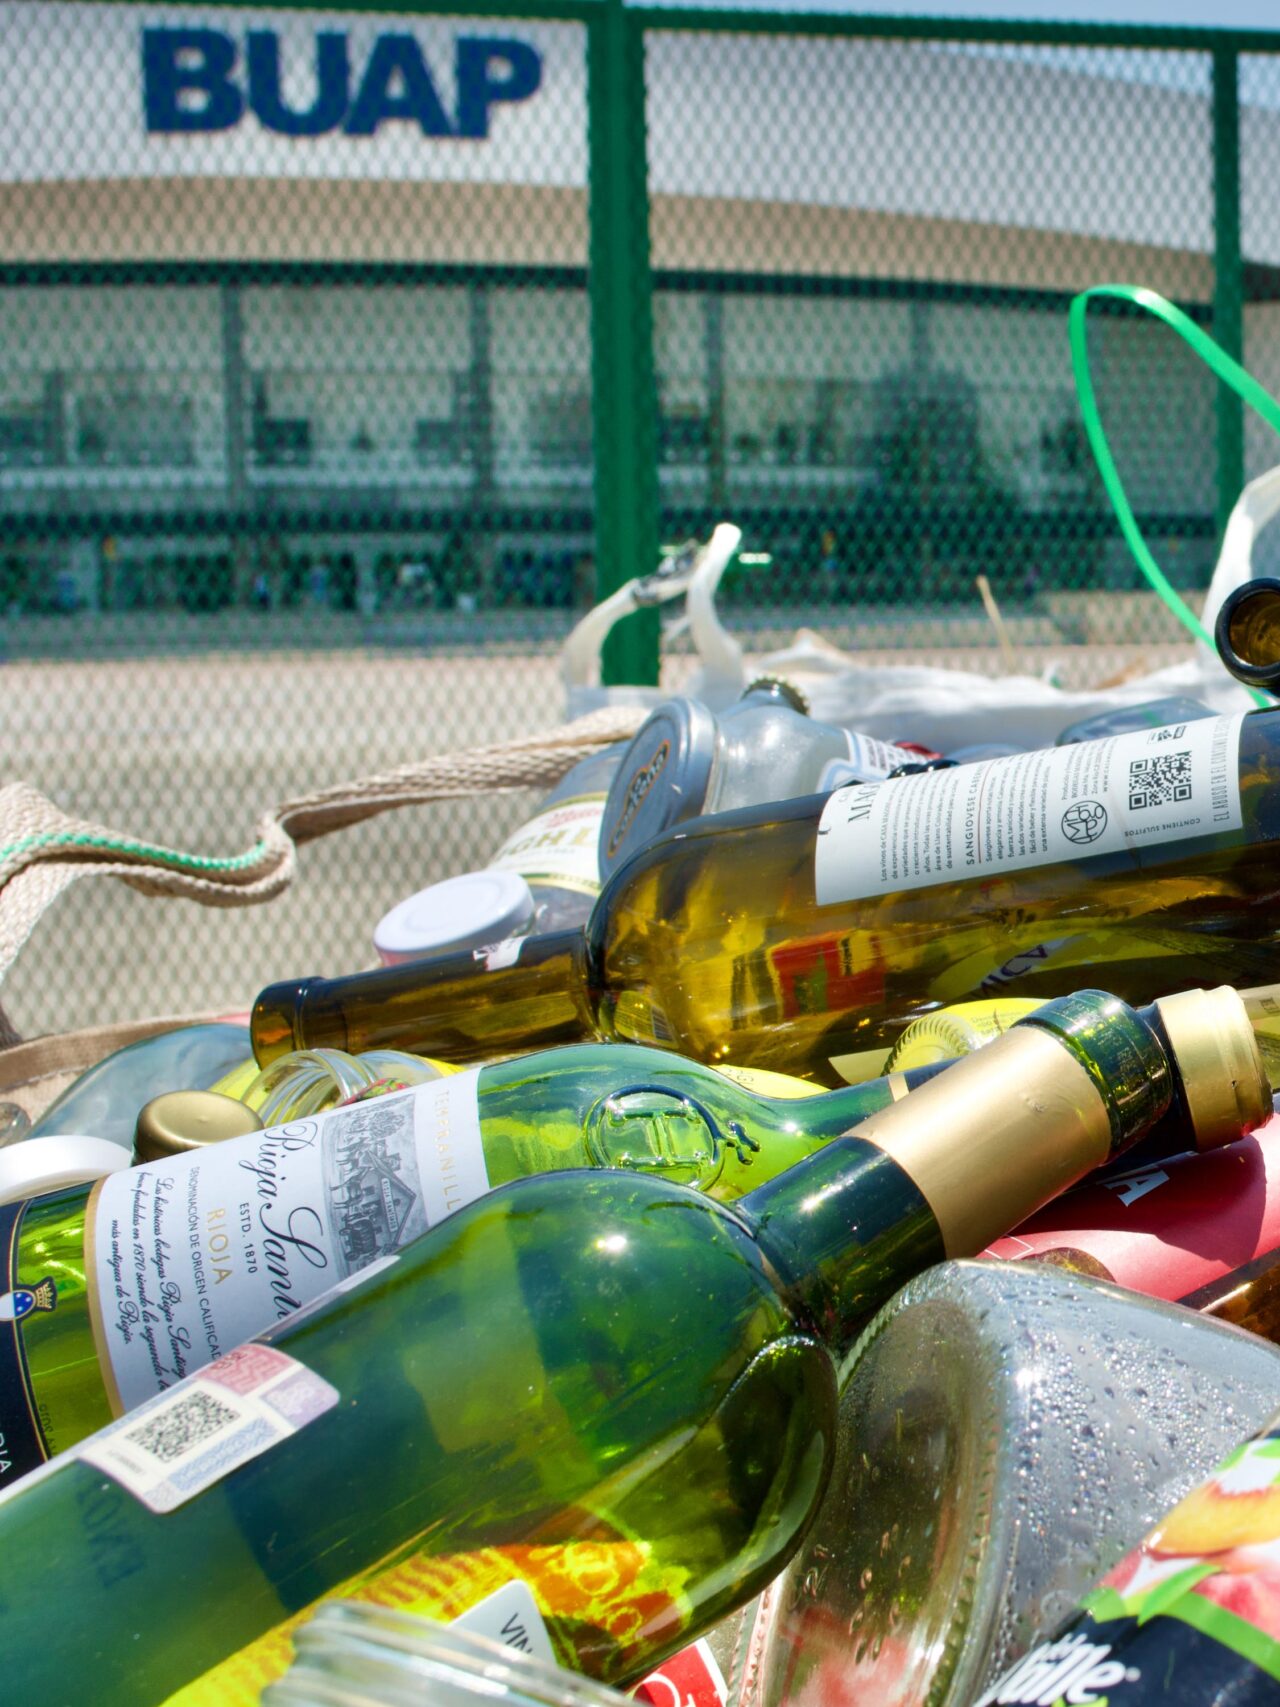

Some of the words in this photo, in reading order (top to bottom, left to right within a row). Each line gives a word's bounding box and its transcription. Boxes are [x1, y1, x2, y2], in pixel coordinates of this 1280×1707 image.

[141, 25, 542, 139] BUAP
[1211, 764, 1225, 772] EL
[1211, 775, 1226, 783] EN
[1212, 785, 1227, 808] ABUSO
[966, 796, 976, 865] SANGIOVESE
[1124, 826, 1159, 836] SULFITOS
[1162, 818, 1200, 829] CONTIENE
[1214, 811, 1229, 820] EL
[934, 846, 940, 854] de
[984, 826, 993, 861] Sangiovese
[996, 829, 1004, 859] elegancia
[1028, 830, 1035, 839] de
[891, 870, 897, 879] de
[945, 860, 952, 869] de
[239, 1118, 318, 1201] Rioja
[151, 1196, 169, 1236] históricas
[187, 1166, 202, 1234] DENOMINACIÓN
[110, 1219, 119, 1240] más
[237, 1201, 251, 1240] ESTD.
[131, 1243, 143, 1271] 1870
[149, 1239, 168, 1278] bodegas
[188, 1235, 199, 1250] DE
[204, 1207, 234, 1287] RIOJA
[243, 1242, 257, 1274] 1870
[110, 1241, 123, 1283] antigua
[189, 1251, 207, 1295] ORIGEN
[135, 1272, 152, 1308] siendo
[156, 1282, 182, 1323] Rioja
[117, 1301, 138, 1344] Rioja.
[140, 1310, 156, 1323] la
[141, 1324, 168, 1372] segunda
